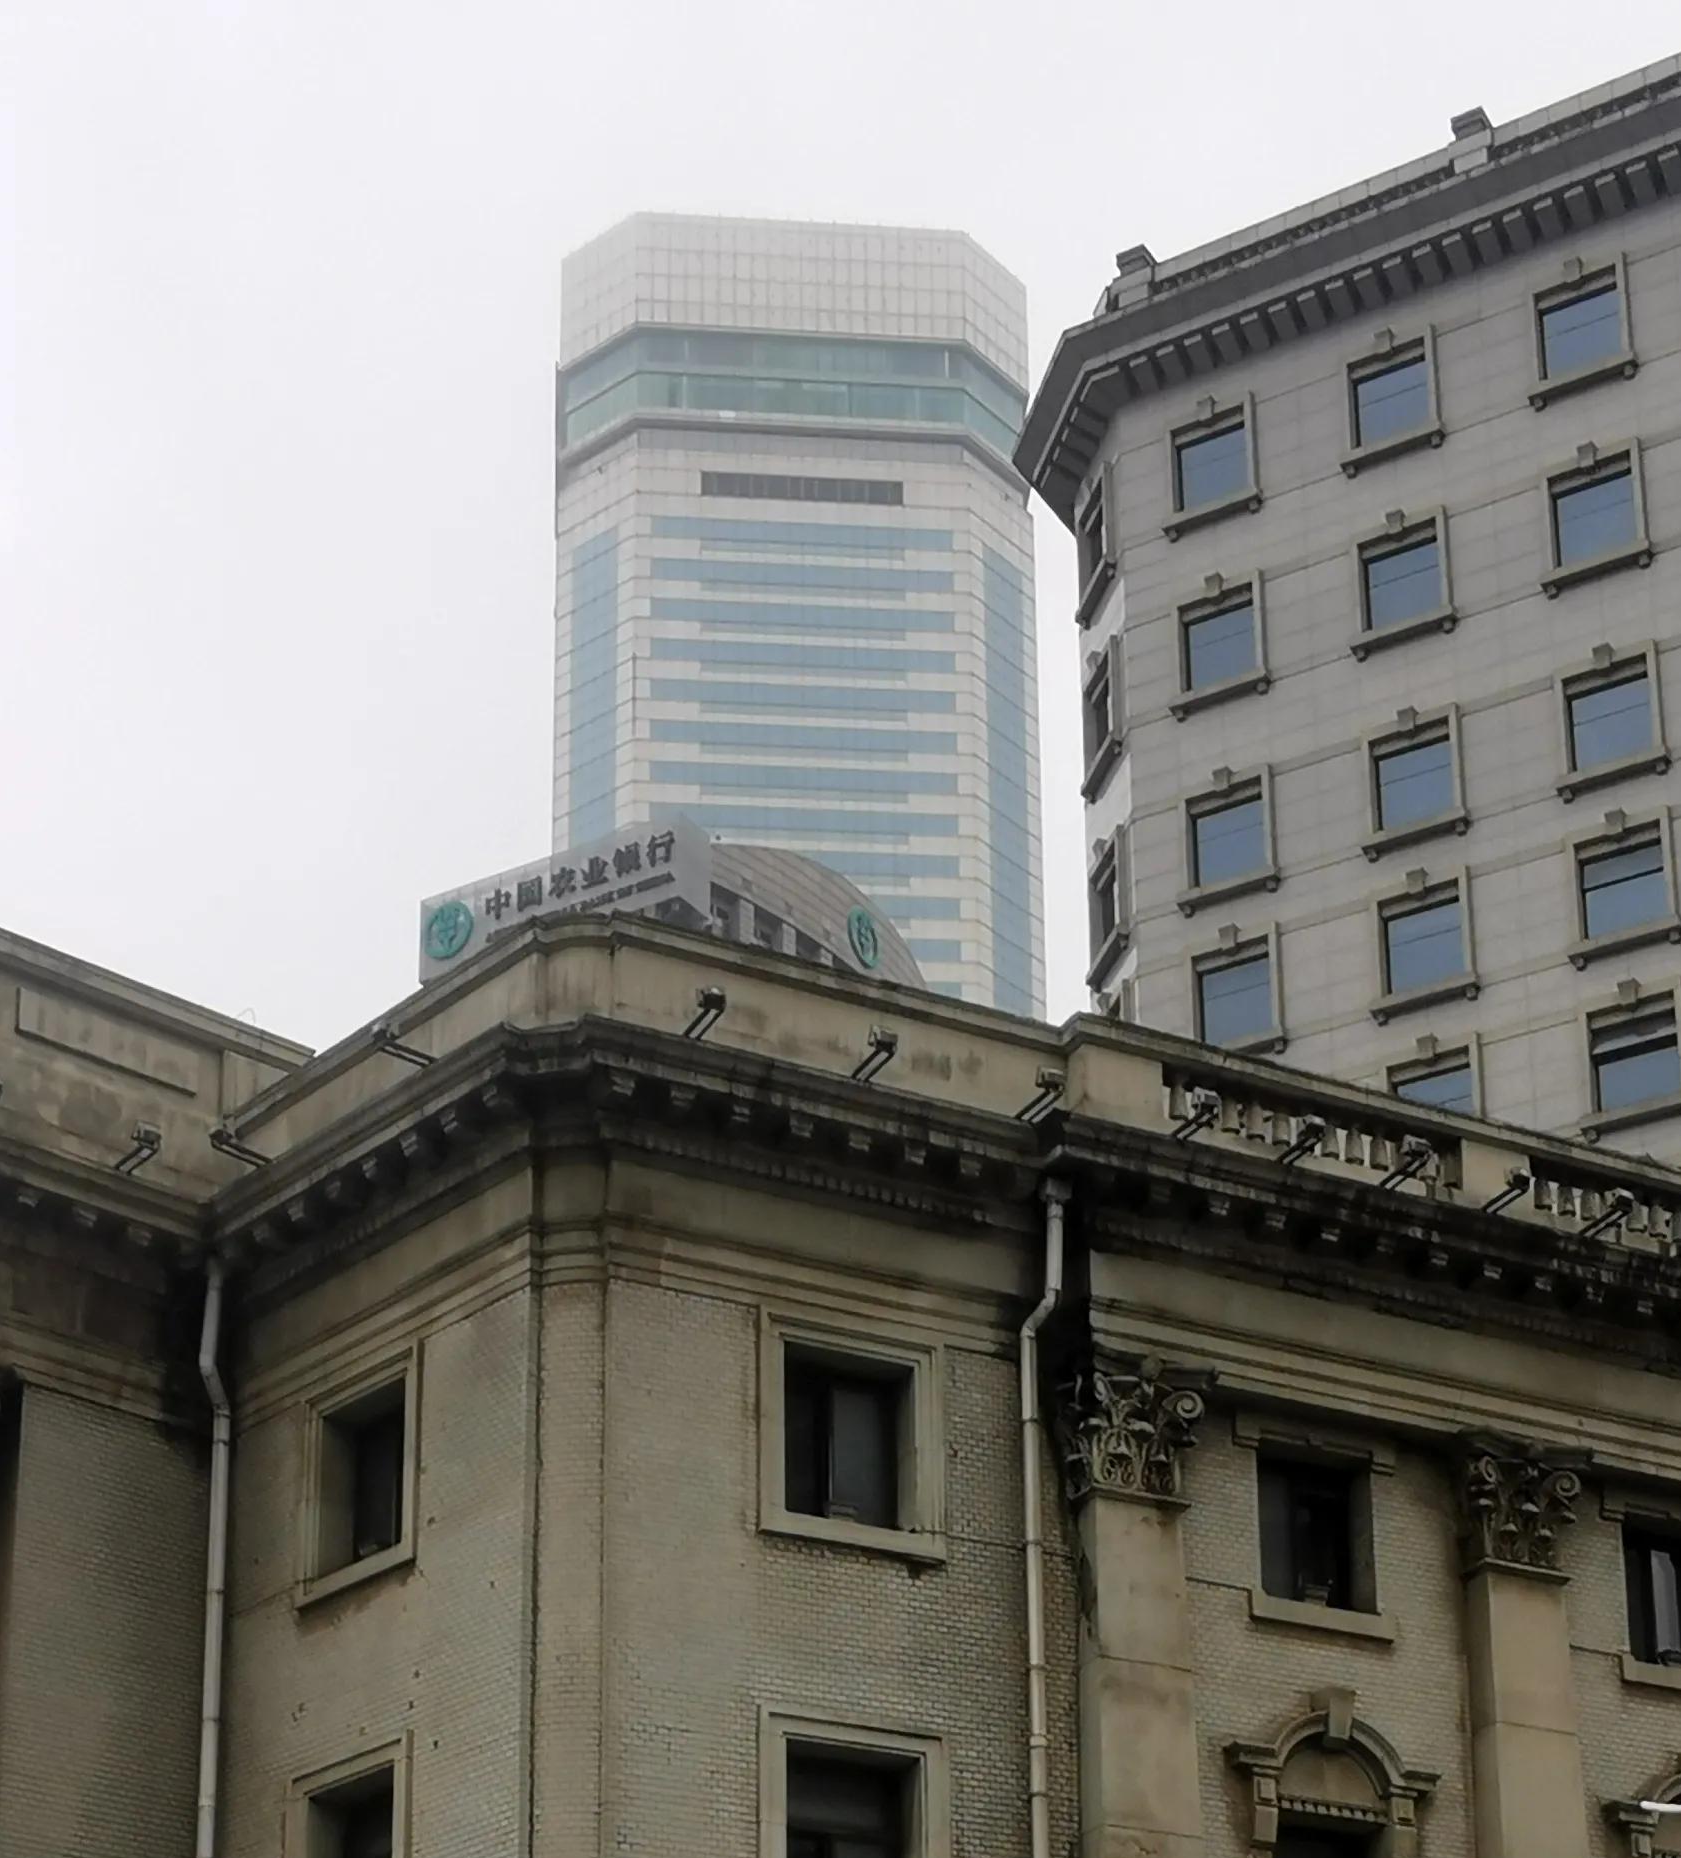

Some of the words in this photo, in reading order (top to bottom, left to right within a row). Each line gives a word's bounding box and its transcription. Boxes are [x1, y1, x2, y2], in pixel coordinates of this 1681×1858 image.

[484, 829, 676, 920] 中国农业银行
